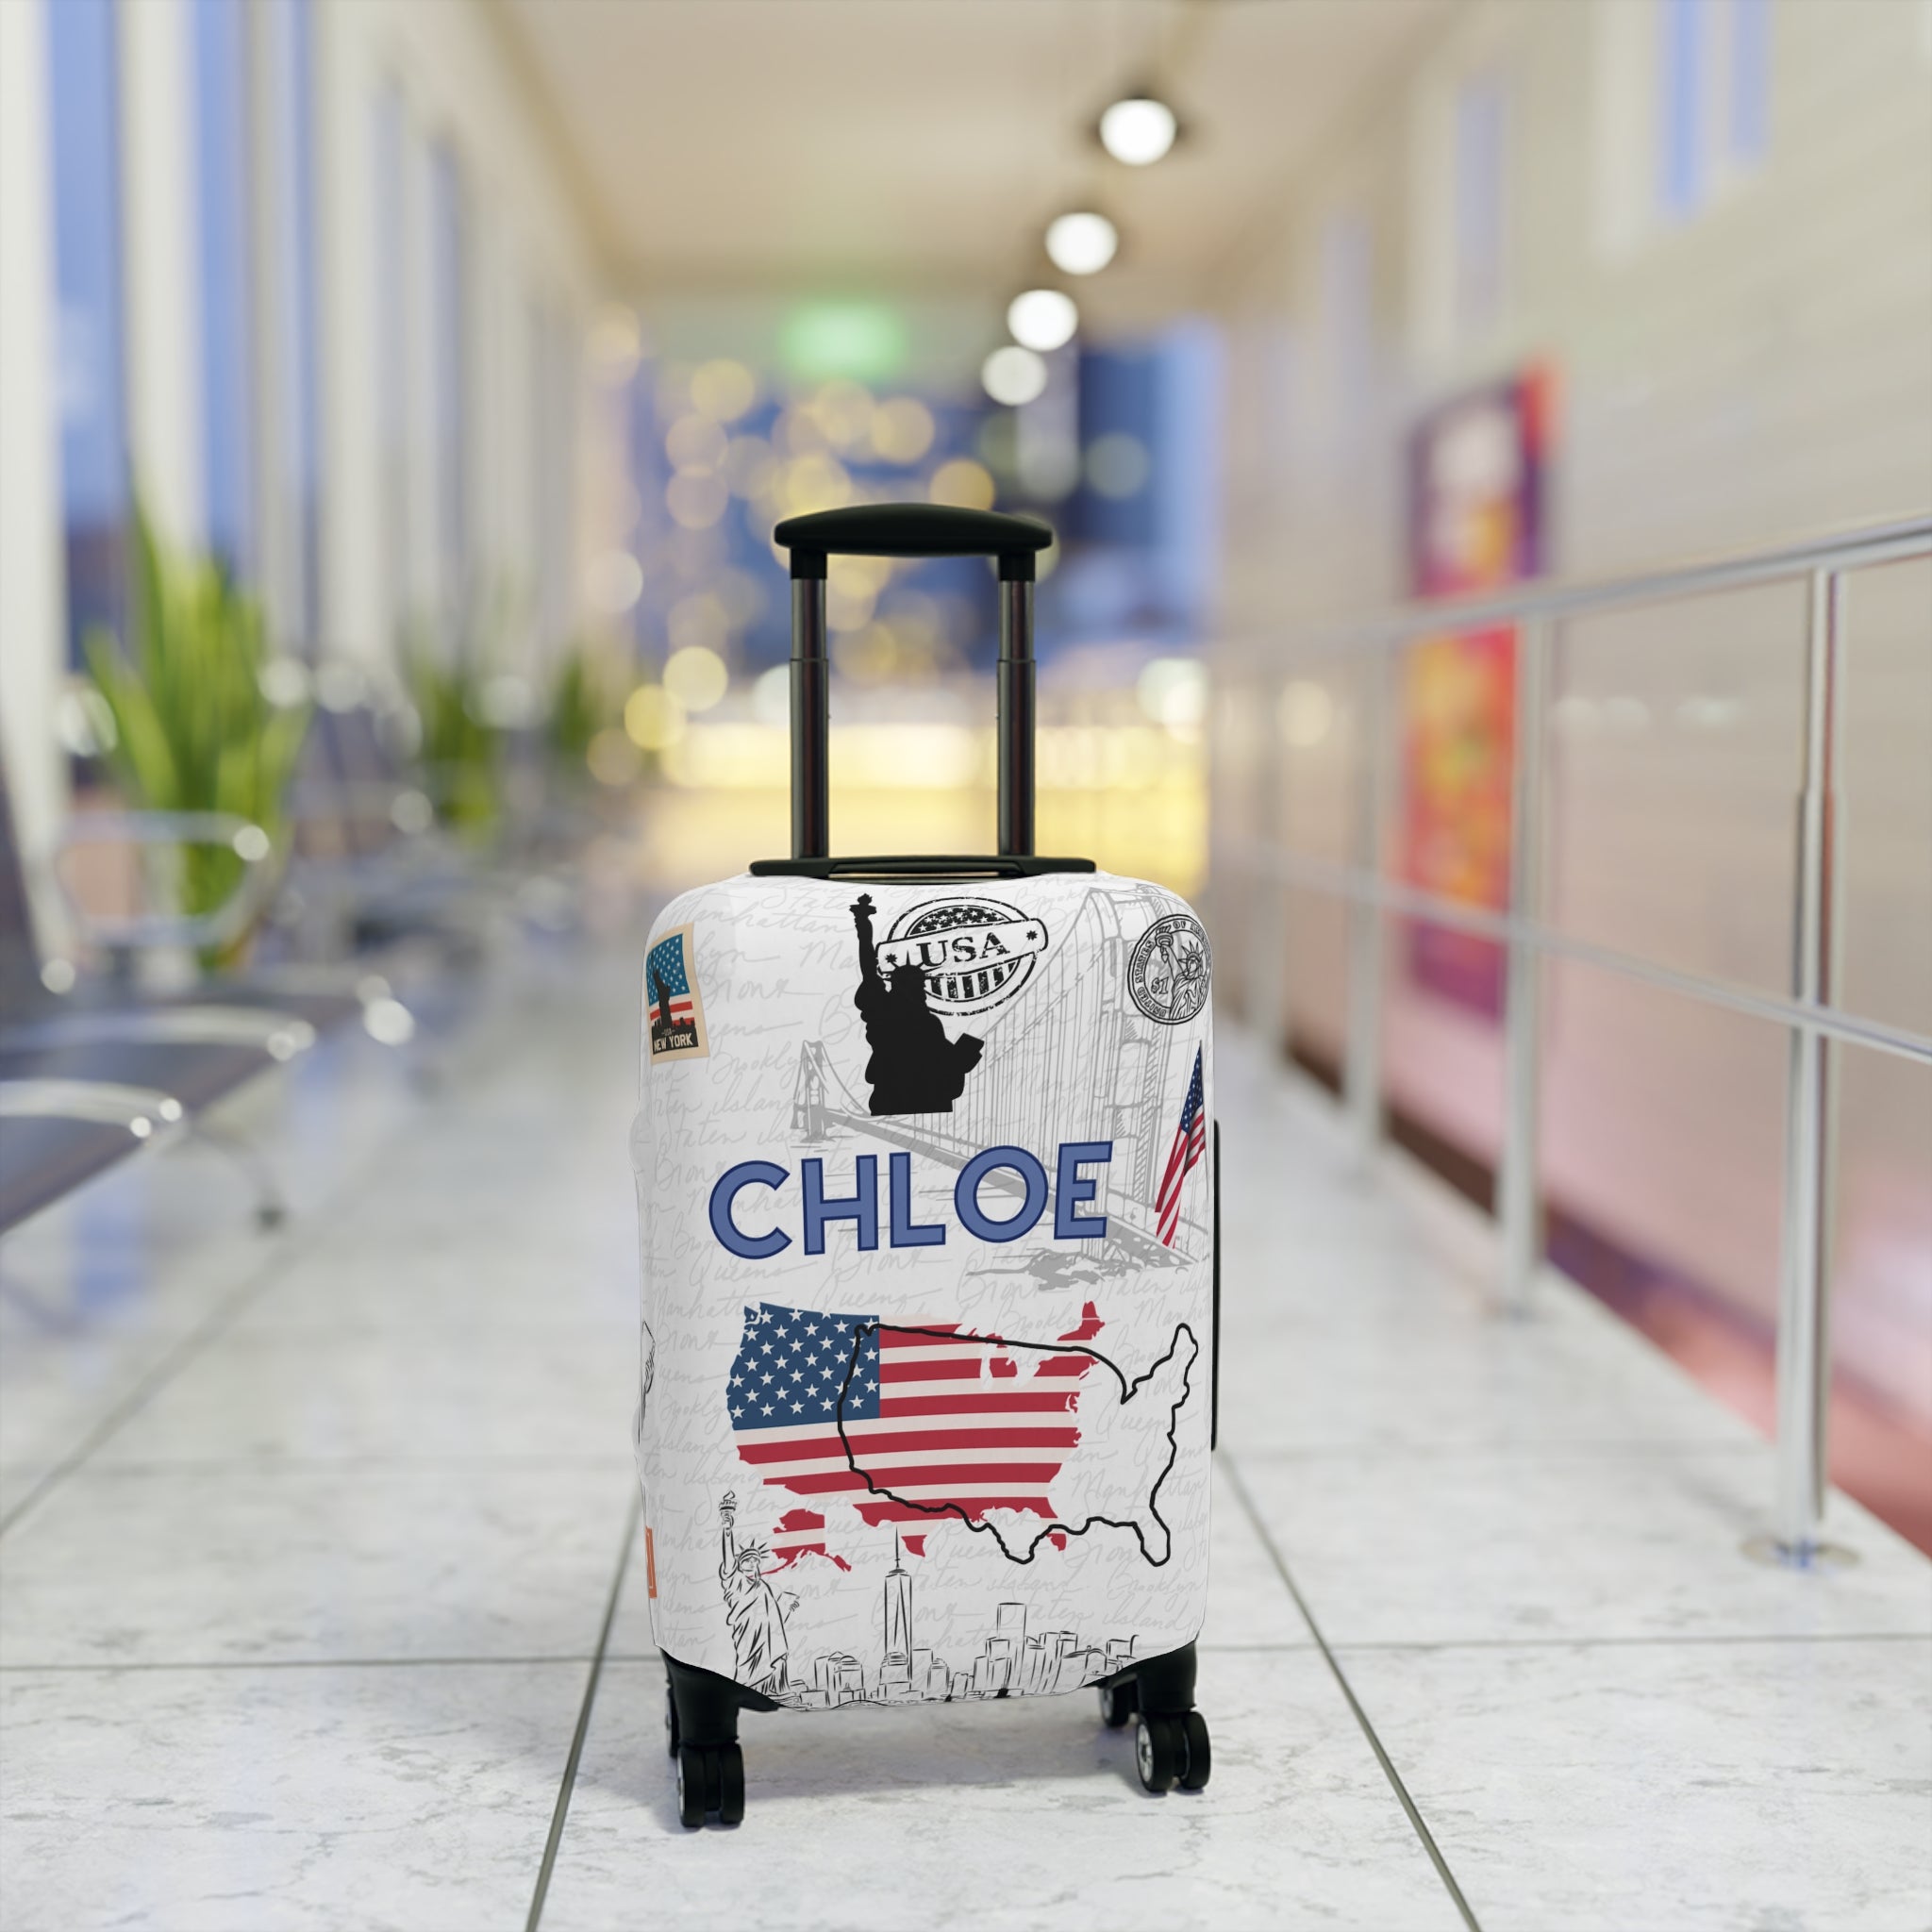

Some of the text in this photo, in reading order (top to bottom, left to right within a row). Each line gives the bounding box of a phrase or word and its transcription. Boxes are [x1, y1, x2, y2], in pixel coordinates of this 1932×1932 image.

[915, 931, 1011, 968] USA
[1135, 940, 1156, 984] STATES
[1137, 986, 1167, 1018] UNITED
[1151, 975, 1170, 995] $1
[653, 1032, 694, 1053] NEW YORK
[708, 1140, 1114, 1260] CHLOE
